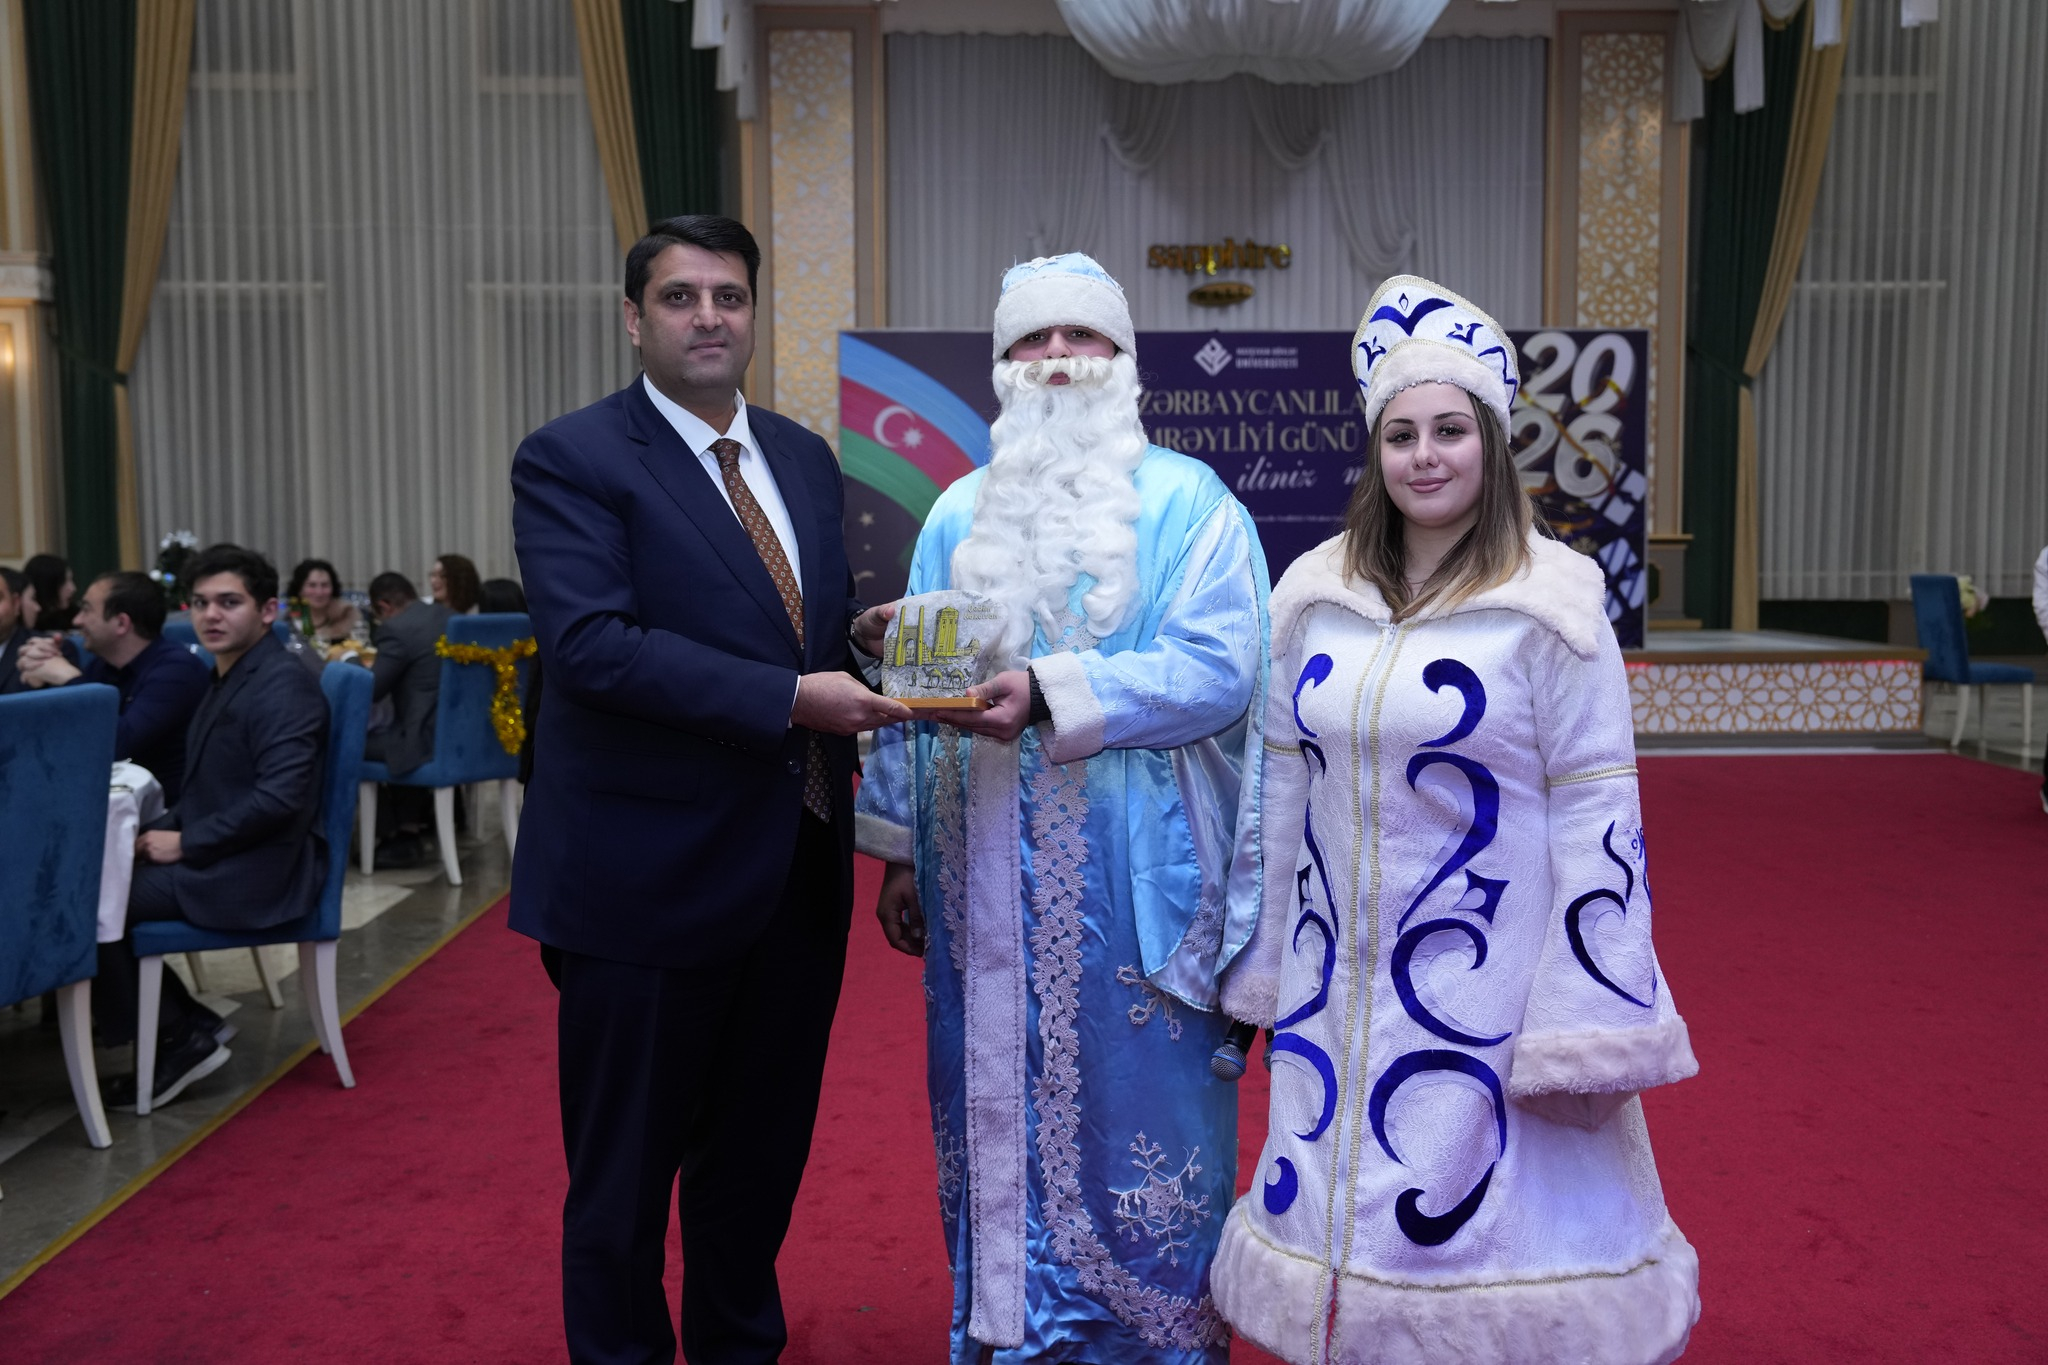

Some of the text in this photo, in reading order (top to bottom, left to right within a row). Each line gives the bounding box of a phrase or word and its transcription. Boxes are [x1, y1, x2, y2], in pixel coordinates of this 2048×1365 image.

[1147, 237, 1291, 276] sapphire
[1511, 331, 1636, 414] 20
[1279, 421, 1360, 453] GÜNÜ
[1510, 408, 1624, 498] 26
[1236, 455, 1318, 493] iliniz
